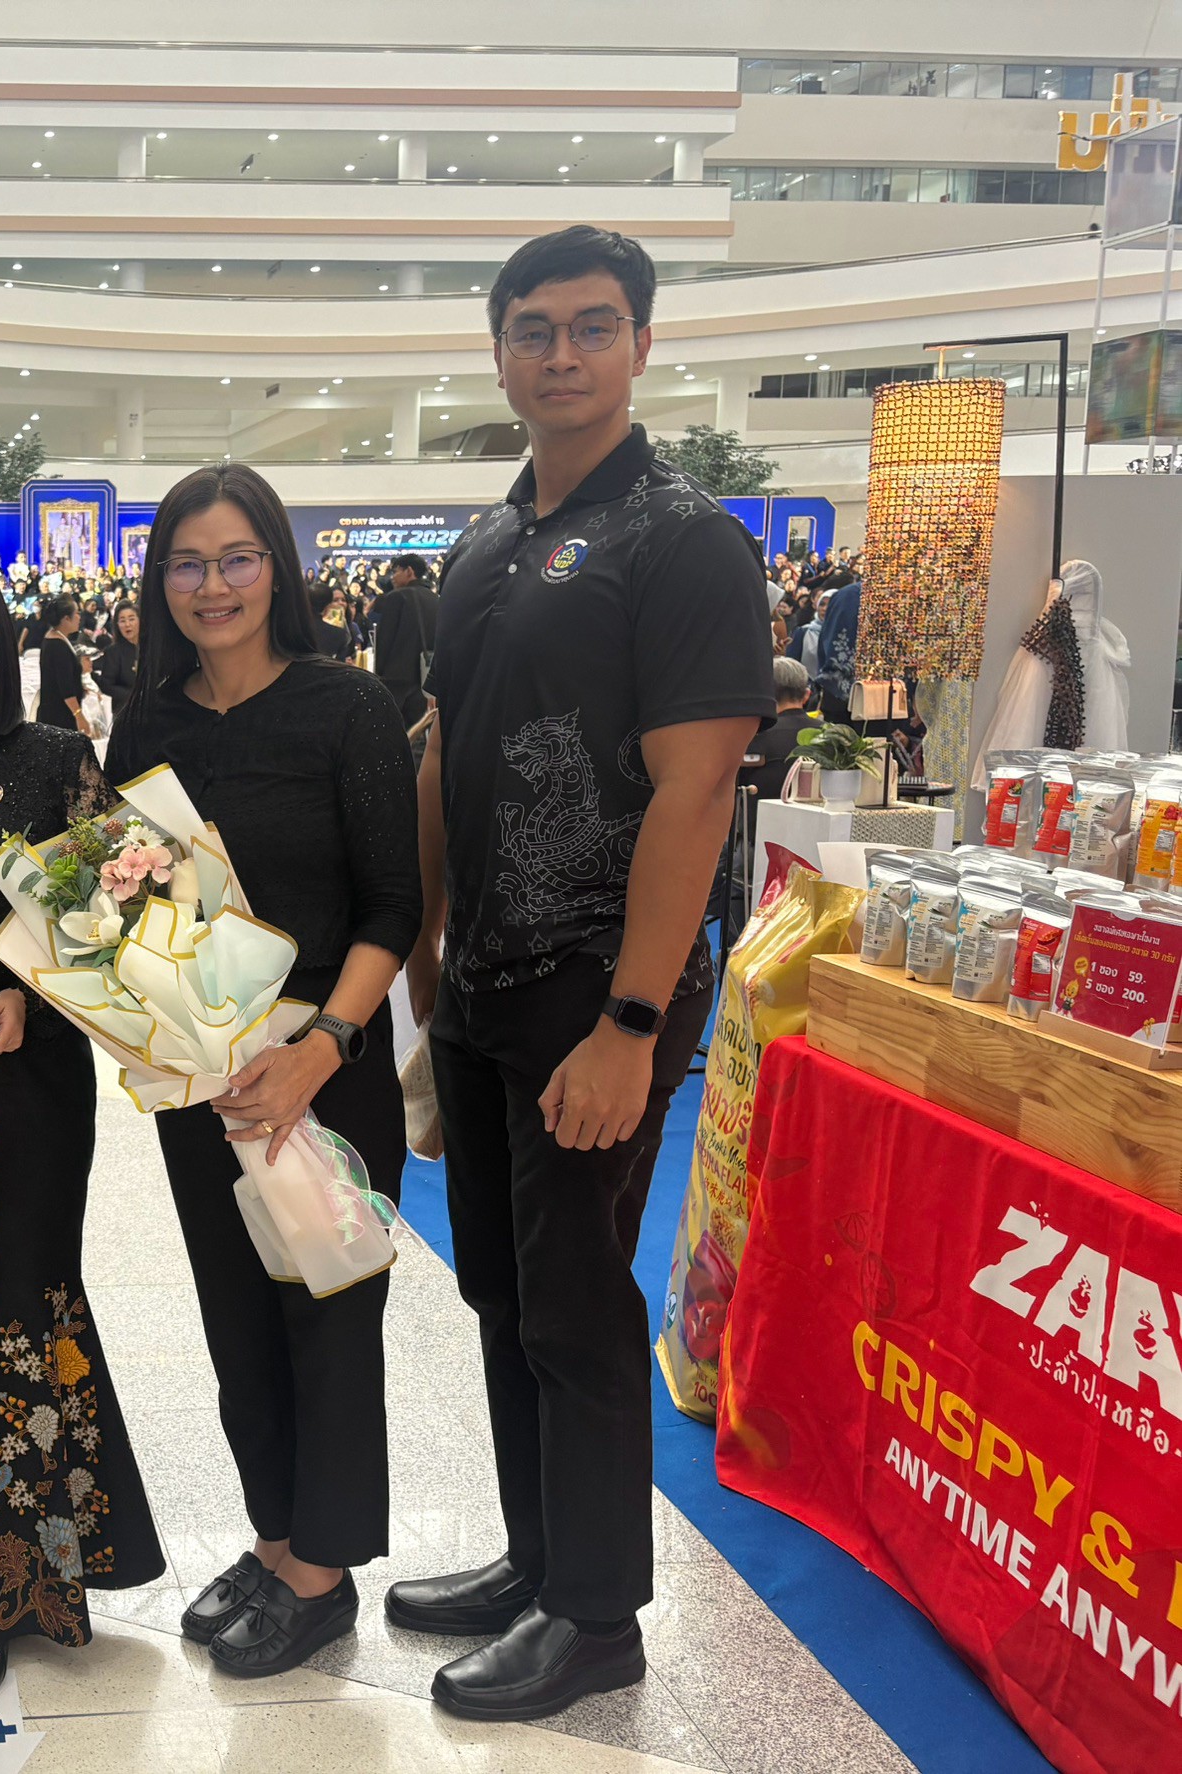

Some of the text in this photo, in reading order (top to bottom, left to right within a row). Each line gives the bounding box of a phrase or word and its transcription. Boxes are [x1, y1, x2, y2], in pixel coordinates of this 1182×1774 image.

[315, 528, 347, 548] CD
[348, 529, 409, 547] NEXT
[1150, 950, 1161, 960] 30
[1161, 952, 1176, 964] กรัม
[1090, 961, 1097, 972] 1
[1099, 965, 1118, 978] ซอง
[1084, 978, 1093, 990] 5
[1095, 982, 1115, 995] ซอง
[970, 1202, 1182, 1422] ZAA
[852, 1320, 1075, 1529] CRISPY
[1080, 1510, 1140, 1600] &
[884, 1436, 1037, 1590] ANYTIME
